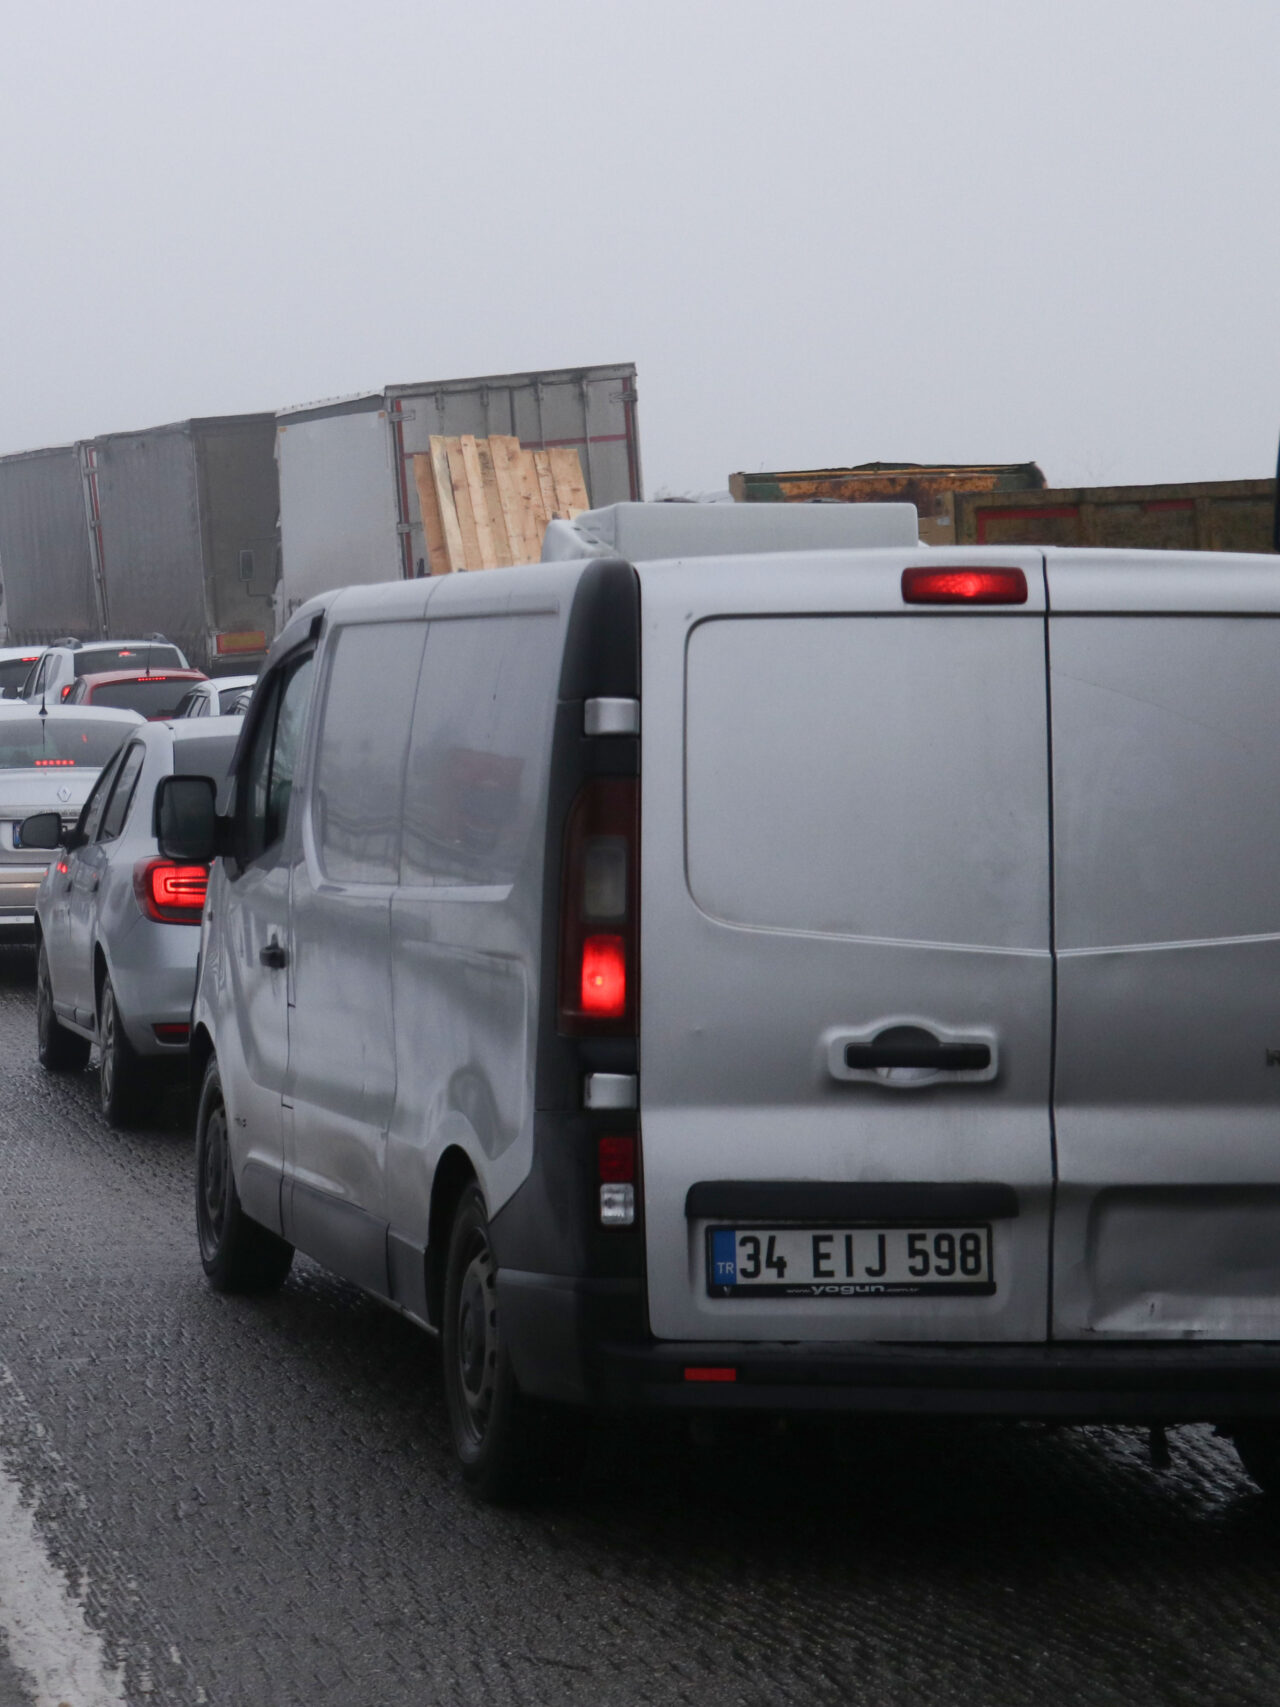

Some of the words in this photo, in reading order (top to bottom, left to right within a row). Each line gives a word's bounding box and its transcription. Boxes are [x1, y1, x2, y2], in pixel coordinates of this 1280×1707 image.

[717, 1262, 735, 1275] TR
[739, 1235, 787, 1279] 34
[812, 1234, 887, 1278] EIJ
[907, 1233, 982, 1278] 598
